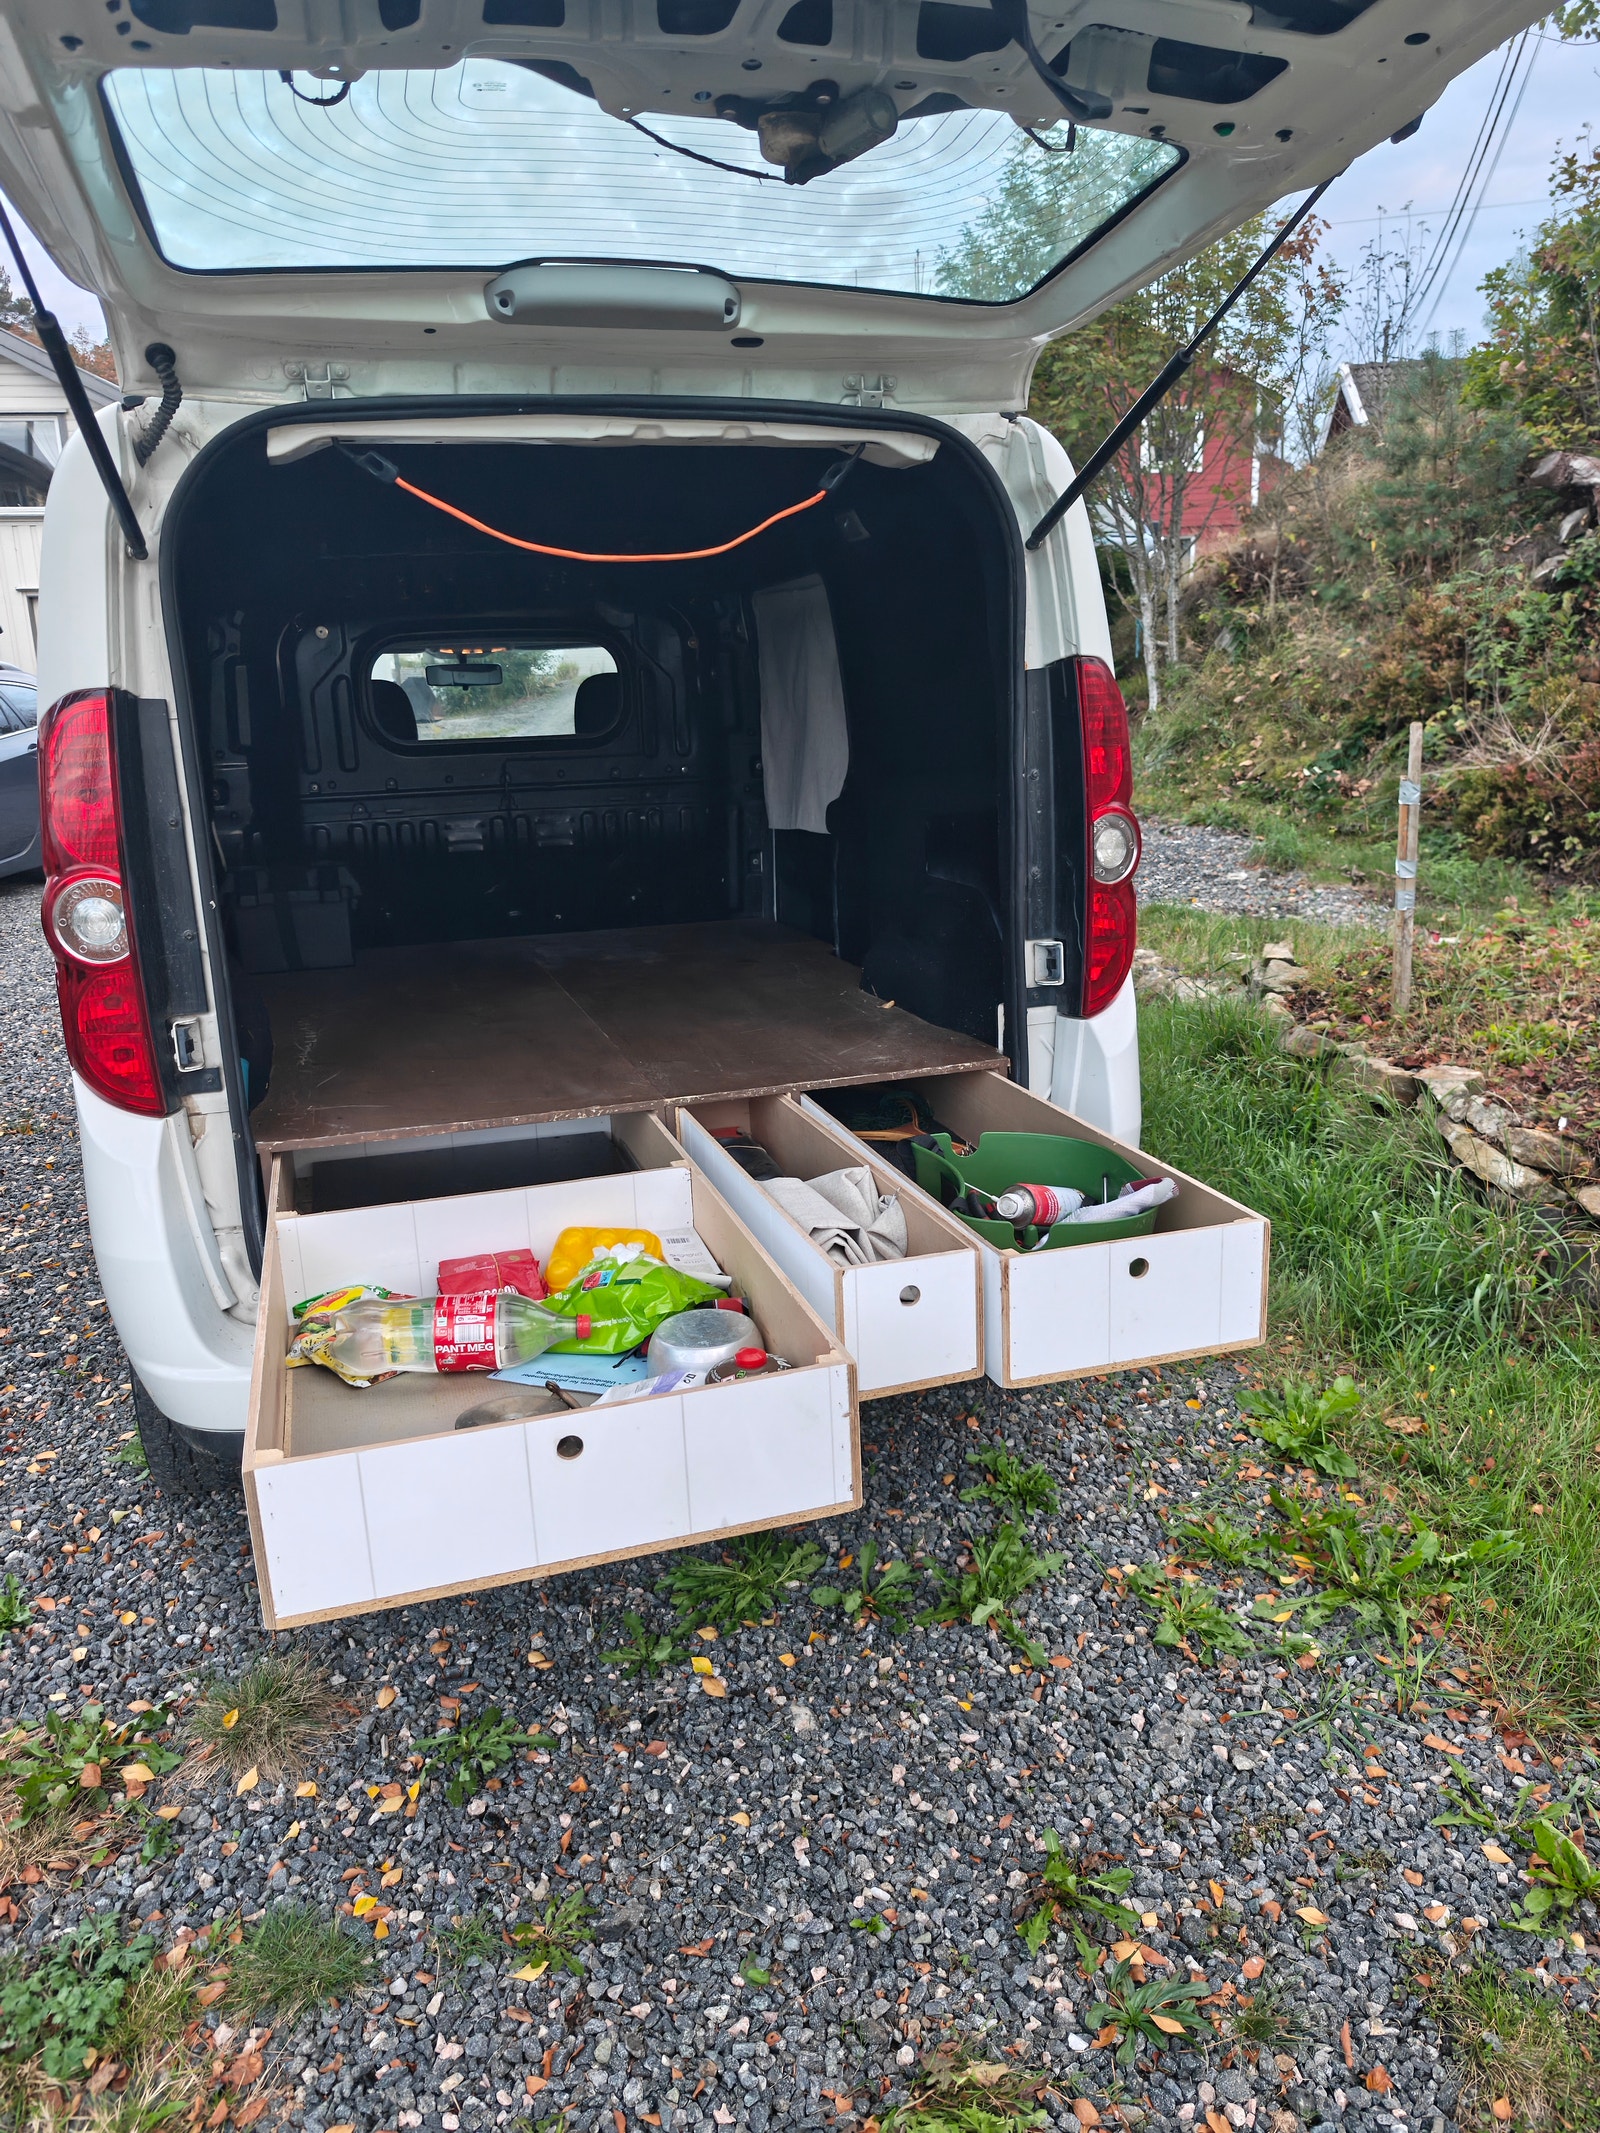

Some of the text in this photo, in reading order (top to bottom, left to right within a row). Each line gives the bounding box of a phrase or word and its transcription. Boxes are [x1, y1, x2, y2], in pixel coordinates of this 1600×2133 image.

[435, 1345, 466, 1354] PANT
[468, 1343, 494, 1352] MEG
[580, 1380, 613, 1388] engerarm
